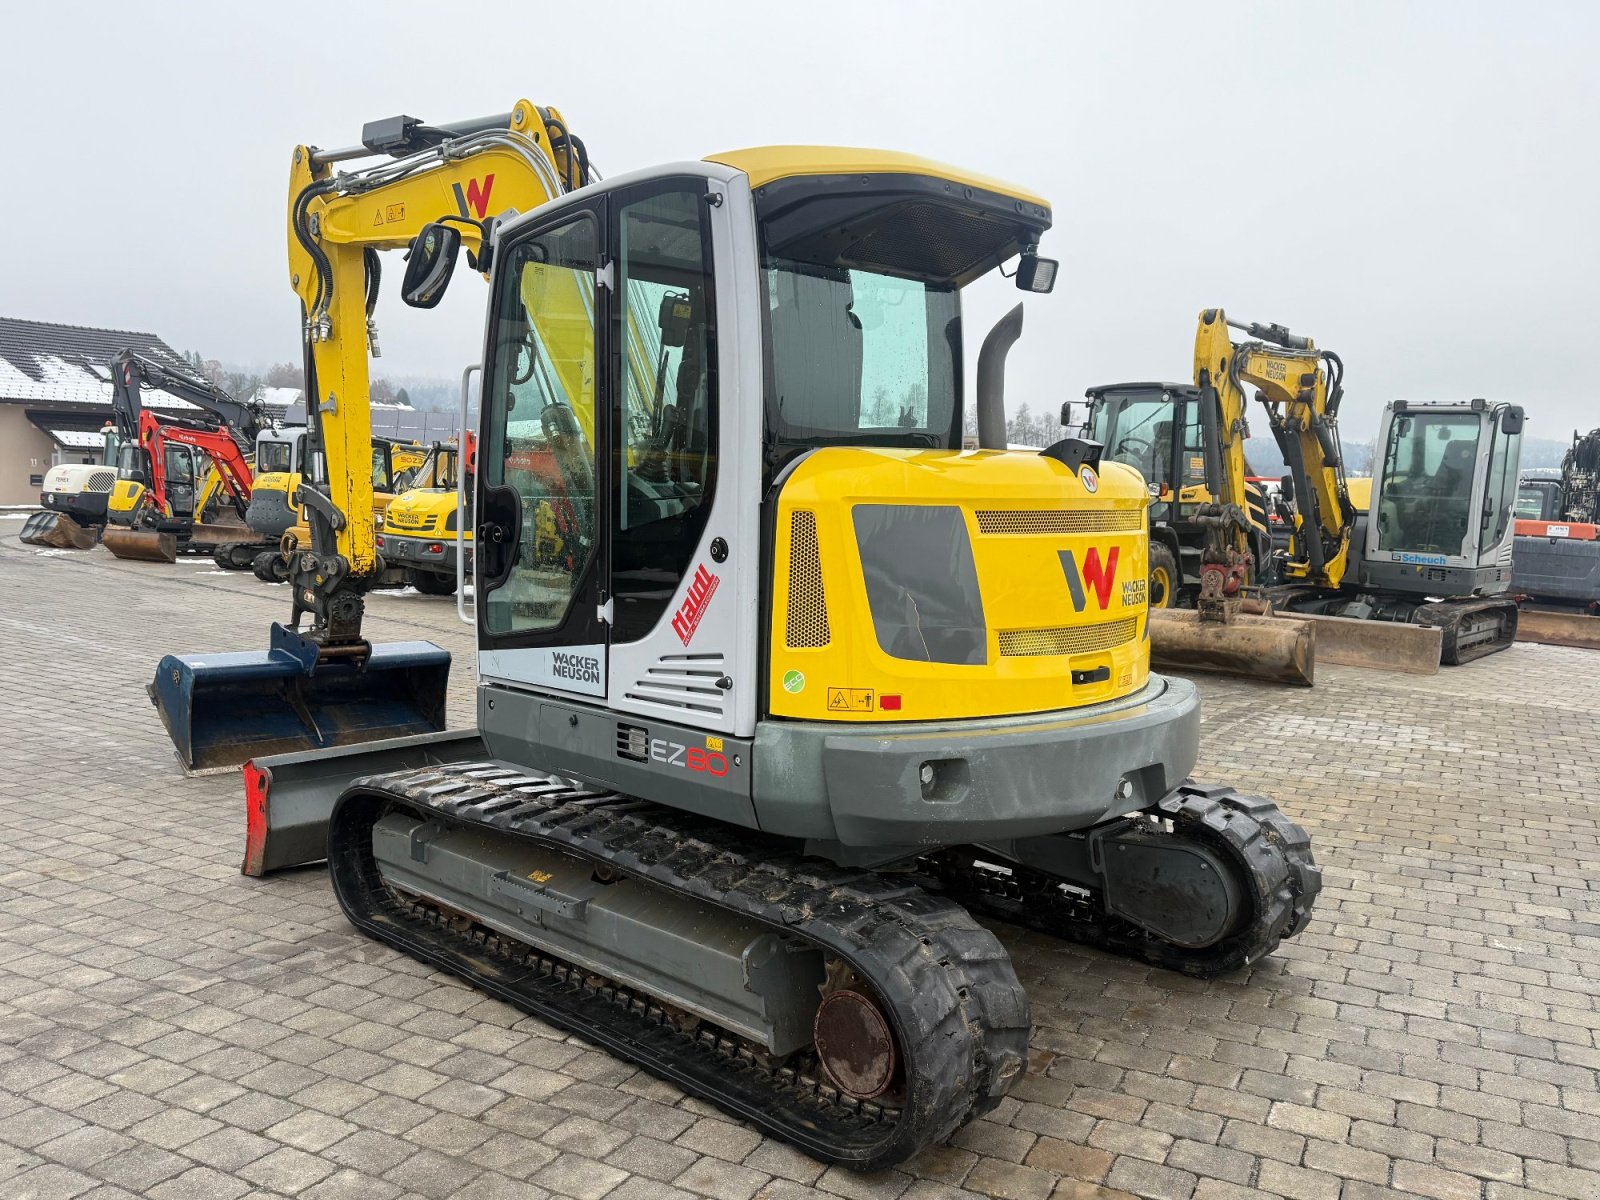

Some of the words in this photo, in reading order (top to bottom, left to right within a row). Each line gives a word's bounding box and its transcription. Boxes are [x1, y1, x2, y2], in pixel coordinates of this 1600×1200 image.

[1266, 360, 1286, 370] WACKER
[1265, 369, 1286, 381] NEUSON
[30, 458, 38, 466] 11
[397, 512, 419, 520] WACKER
[1402, 553, 1446, 565] Scheuch
[1122, 579, 1146, 593] WACKER
[1122, 591, 1146, 606] NEUSON
[552, 651, 599, 671] WACKER
[553, 664, 600, 684] NEUSON
[785, 673, 804, 690] ECO
[650, 738, 729, 777] EZ80
